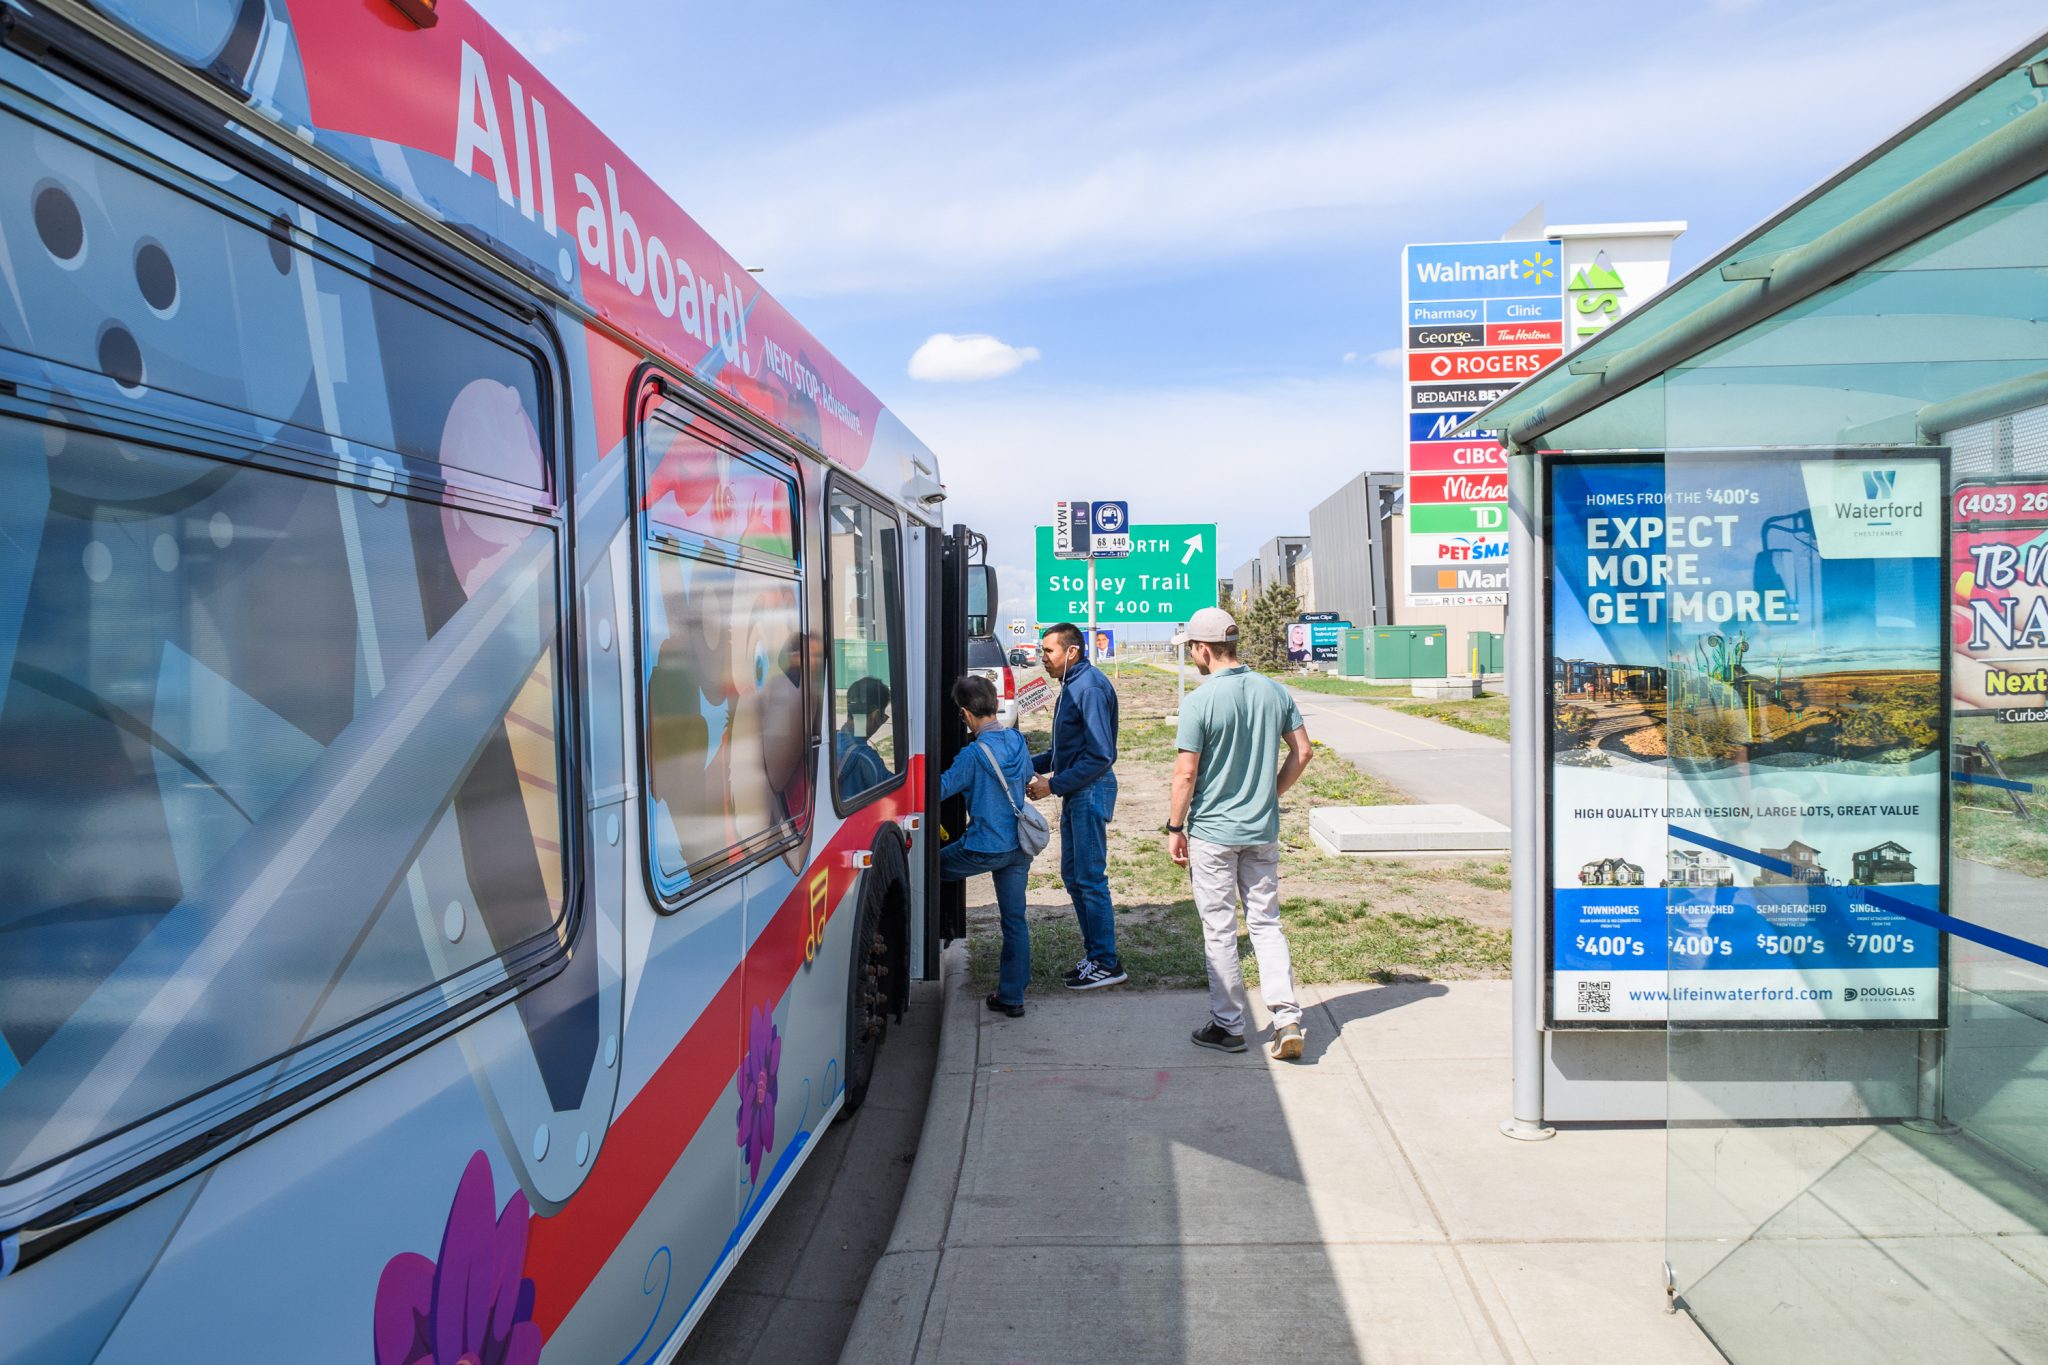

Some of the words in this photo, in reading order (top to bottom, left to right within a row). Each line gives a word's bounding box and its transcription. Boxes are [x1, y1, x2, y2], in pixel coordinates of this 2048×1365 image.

[454, 39, 557, 238] All
[574, 162, 751, 375] aboard!
[1417, 259, 1519, 283] Walmart
[1414, 308, 1477, 321] Pharmacy
[1507, 304, 1542, 317] Clinic
[1497, 329, 1514, 341] Tim
[1515, 328, 1550, 341] Hortons
[764, 336, 793, 384] NEXT
[794, 360, 822, 405] STOP:
[1457, 354, 1541, 373] ROGERS
[1417, 391, 1438, 403] BED
[1439, 391, 1468, 402] BATH
[1468, 390, 1477, 402] &
[1453, 447, 1498, 464] CIBC
[1586, 494, 1634, 506] HOMES
[1637, 493, 1672, 505] FROM
[1676, 492, 1702, 504] THE
[1705, 488, 1760, 505] $400's
[1958, 494, 2017, 516] (403)
[1470, 506, 1503, 529] TD
[1835, 501, 1923, 519] Waterford
[1057, 509, 1068, 536] MAX
[1587, 515, 1739, 549] EXPECT
[1097, 537, 1107, 546] 68
[1113, 537, 1126, 546] 440
[1588, 554, 1712, 587] MORE.
[1969, 543, 2018, 588] TB
[1138, 573, 1191, 590] Trail
[1457, 568, 1509, 589] Mar
[1069, 601, 1105, 614] EXT
[1115, 600, 1150, 614] 400
[1158, 602, 1173, 613] m
[1588, 592, 1667, 624] GET
[1672, 590, 1800, 623] MORE.
[1014, 626, 1025, 634] 60
[1987, 670, 2048, 693] Next
[1021, 693, 1044, 708] DELIVERY
[1574, 808, 1603, 819] HIGH
[1607, 808, 1658, 819] QUALITY
[1661, 807, 1701, 818] URBAN
[1704, 807, 1754, 819] DESIGN,
[1757, 806, 1797, 817] LARGE
[1800, 806, 1834, 819] LOTS,
[1837, 806, 1877, 817] GREAT
[1879, 805, 1920, 817] VALUE
[1582, 905, 1640, 915] TOWNHOMES
[1756, 904, 1827, 914] SEMI-DETACHED
[1576, 935, 1645, 956] $400's
[1667, 935, 1733, 956] $400's
[1756, 933, 1825, 954] $500's
[1847, 932, 1915, 954] $700's
[1629, 986, 1833, 1000] www.lifeinwaterford.com
[1860, 987, 1915, 996] DOUGLAS
